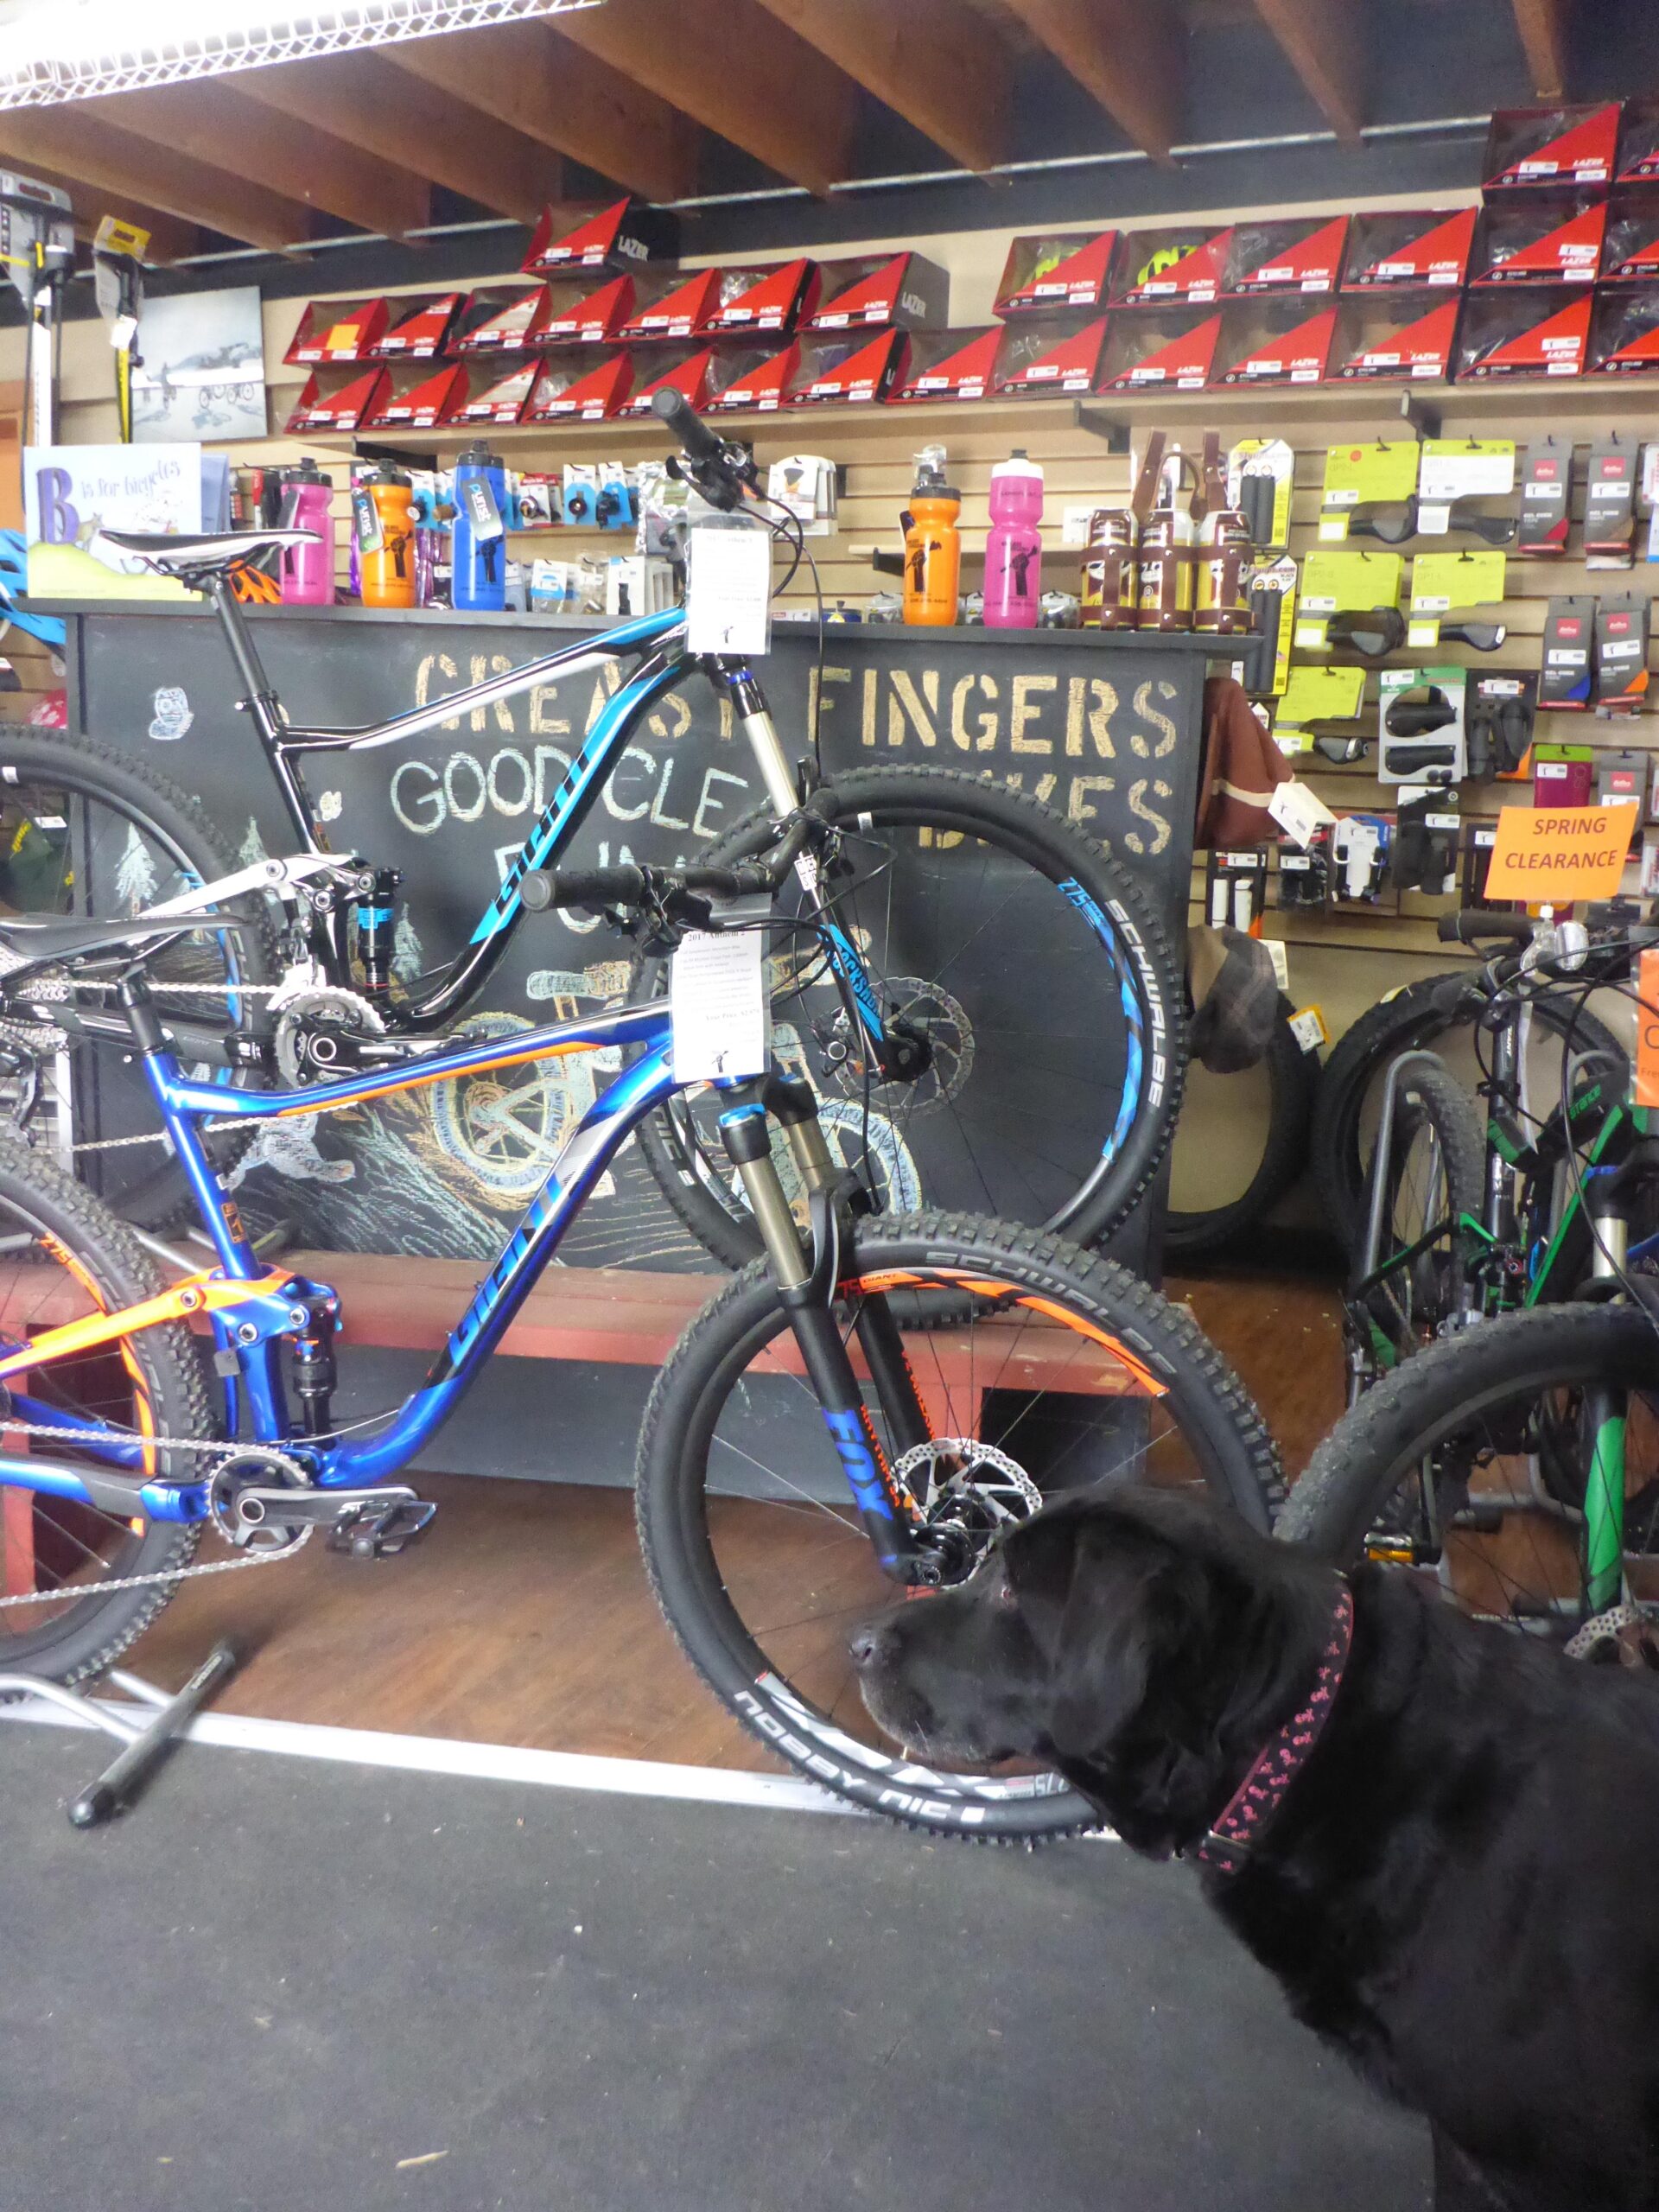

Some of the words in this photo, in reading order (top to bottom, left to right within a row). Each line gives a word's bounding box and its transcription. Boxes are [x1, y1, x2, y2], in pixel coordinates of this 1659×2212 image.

[1573, 158, 1604, 167] LAZER
[618, 235, 650, 262] LAZER
[1428, 262, 1459, 270] LAZER
[1069, 281, 1096, 289] LAZER
[1188, 279, 1216, 288] LAZER
[902, 292, 926, 319] LAZER
[1062, 368, 1088, 377] LAZER
[36, 467, 79, 547] B
[81, 481, 94, 499] is
[98, 478, 120, 498] for
[808, 665, 1178, 760] FINGERS
[390, 745, 575, 836] GOOD
[1532, 817, 1608, 836] SPRING
[1505, 849, 1618, 869] CLEARANCE
[1104, 899, 1166, 1109] SCHWALBE
[925, 1250, 1177, 1376] SCHWALBE
[821, 1406, 894, 1521] FOX
[734, 1690, 867, 1790] NOBBY
